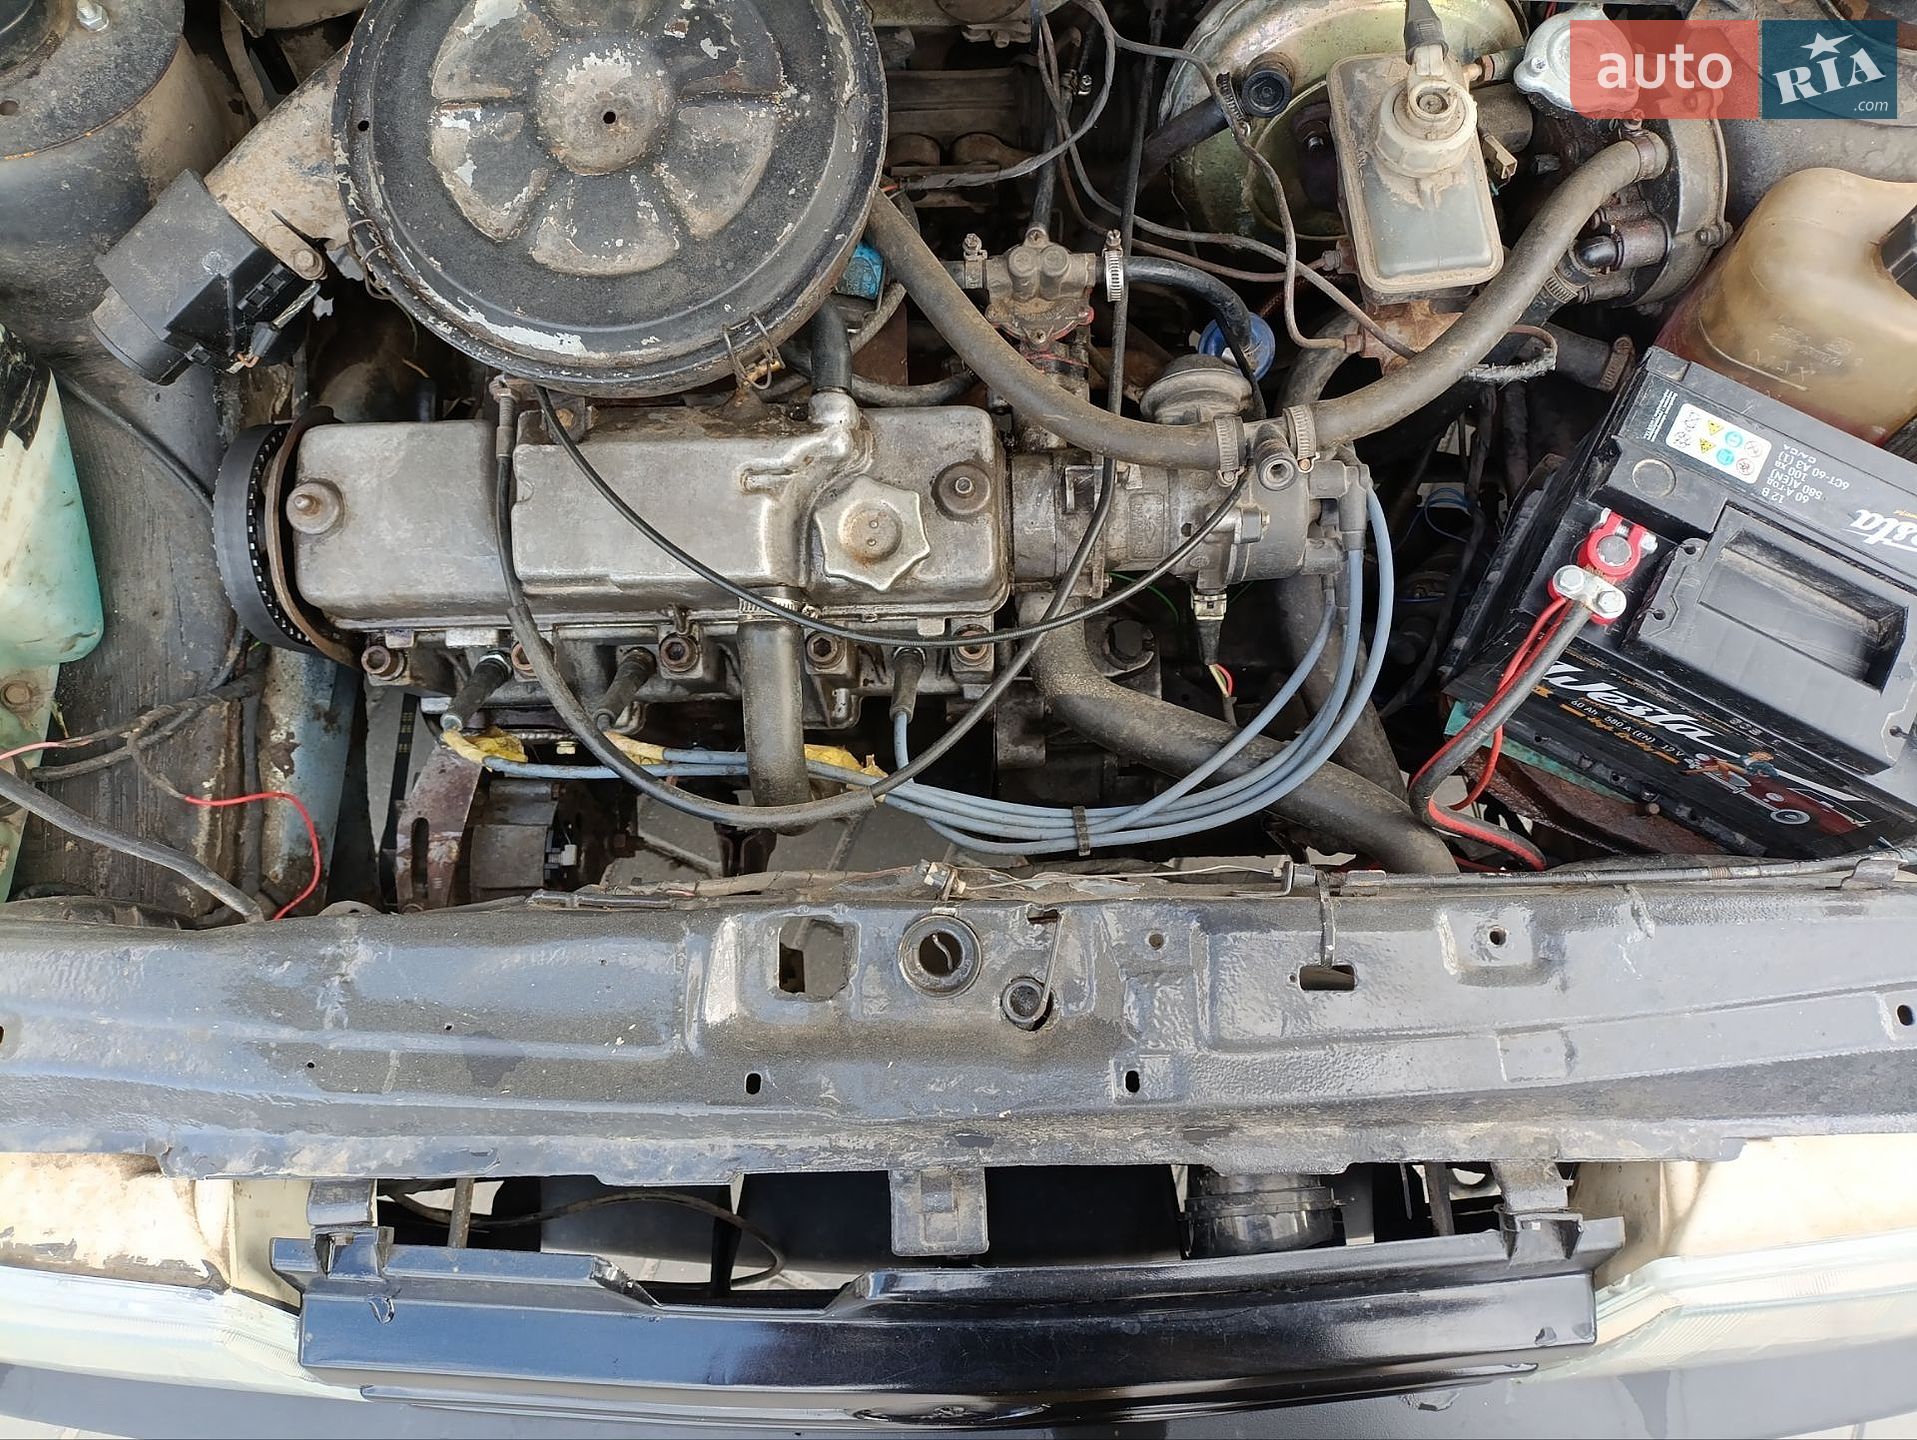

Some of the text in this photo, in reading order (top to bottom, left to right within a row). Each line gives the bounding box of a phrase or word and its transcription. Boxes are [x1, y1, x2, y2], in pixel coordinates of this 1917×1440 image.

[1778, 451, 1794, 465] (1)
[1788, 467, 1809, 482] 100
[1772, 490, 1785, 504] 12
[1795, 492, 1810, 504] 60
[1802, 485, 1823, 500] 580
[1543, 660, 1730, 748] Westa
[1570, 700, 1584, 709] 60
[1583, 706, 1599, 716] Ah
[1604, 715, 1624, 728] 580
[1632, 728, 1656, 743] (EN)
[1661, 743, 1675, 752] 12
